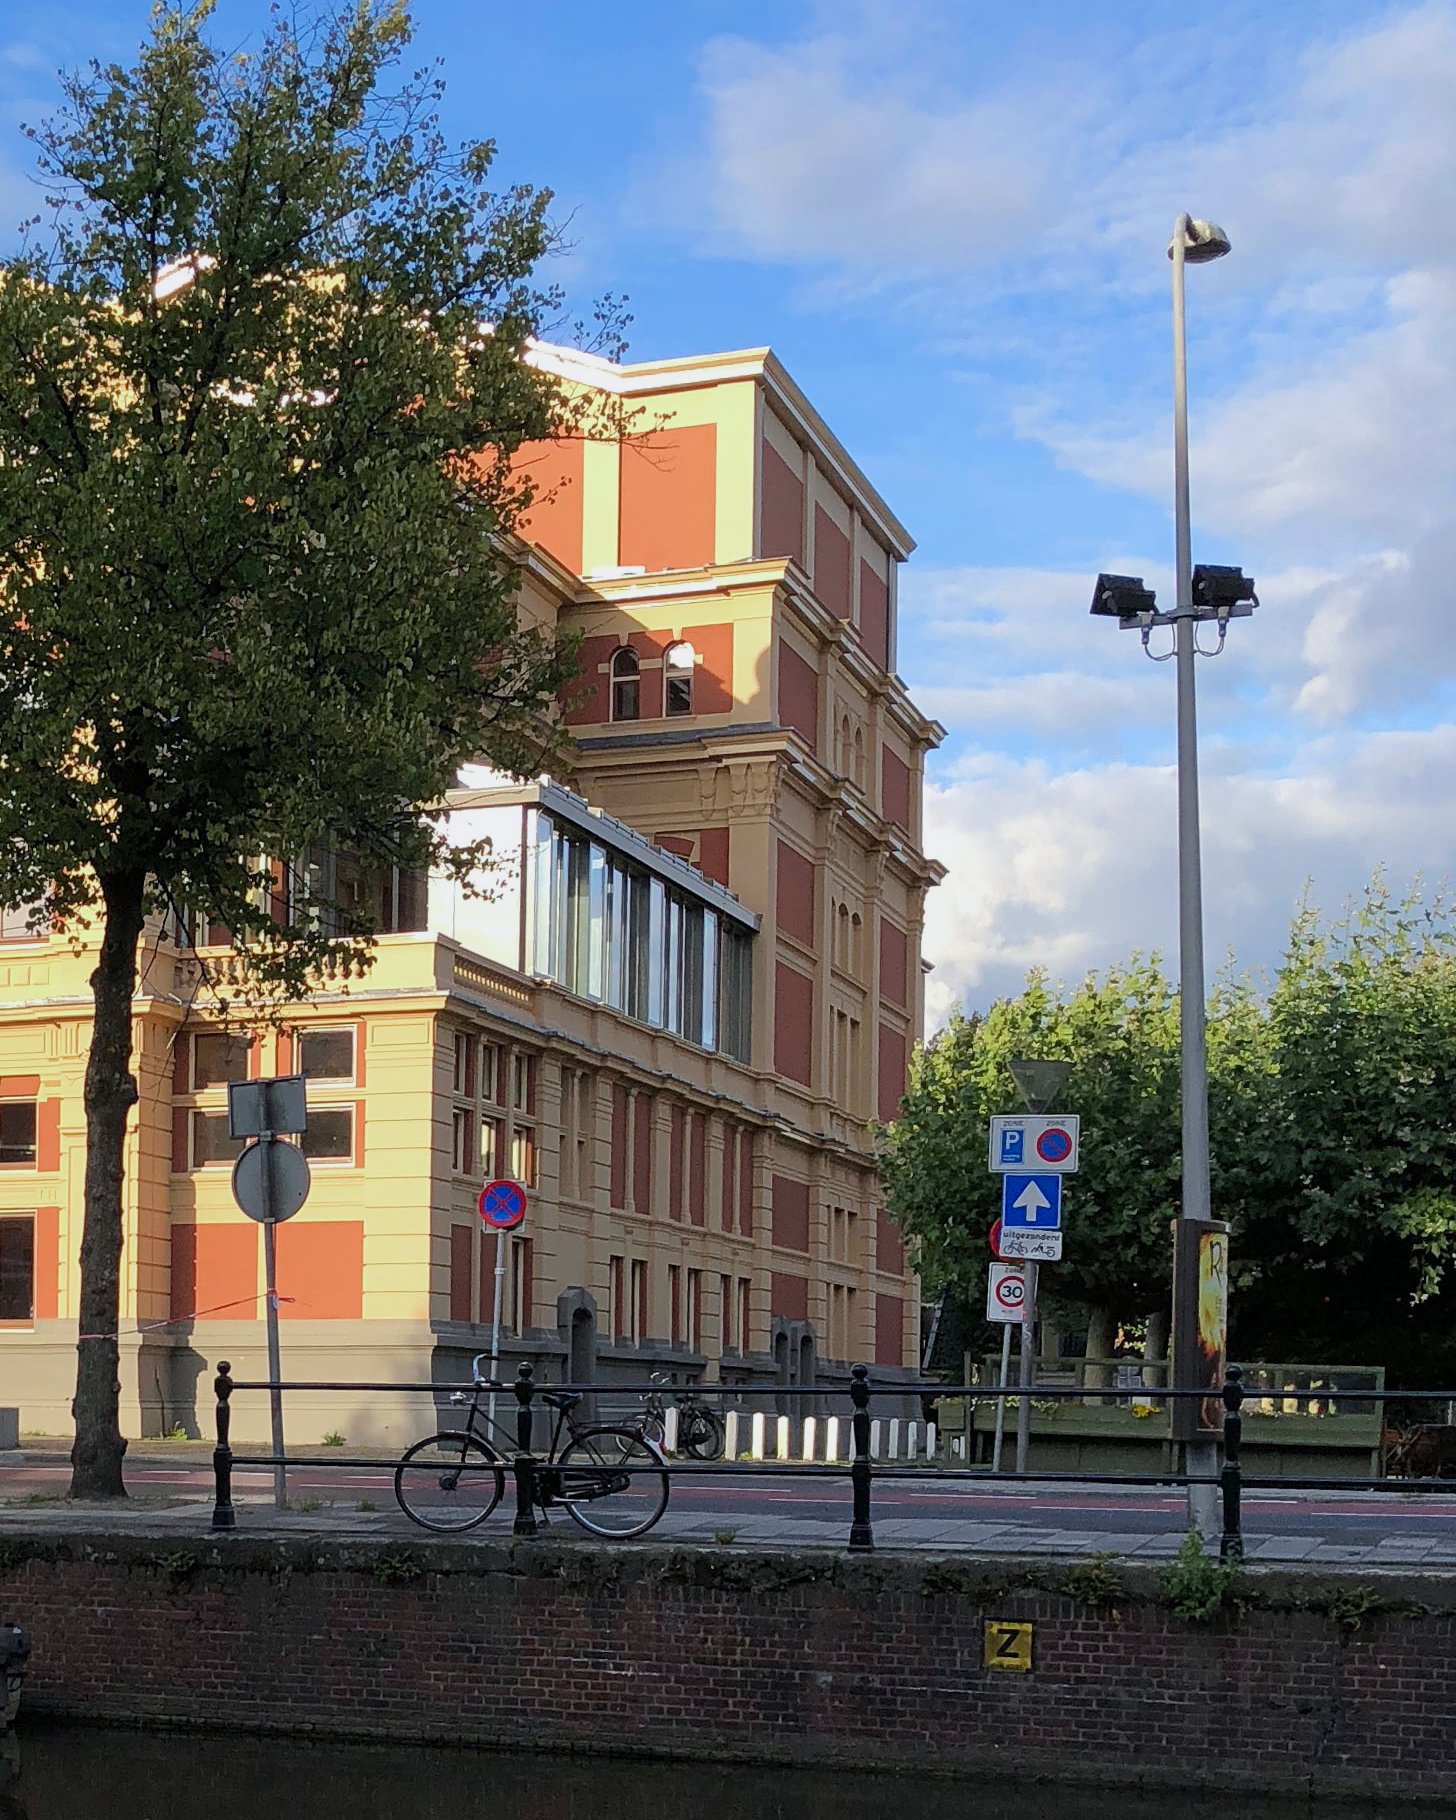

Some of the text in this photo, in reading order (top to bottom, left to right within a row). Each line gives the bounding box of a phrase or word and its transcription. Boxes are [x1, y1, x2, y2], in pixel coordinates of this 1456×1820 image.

[1005, 1131, 1020, 1150] P
[1003, 1230, 1061, 1242] uitgezonderd
[1002, 1285, 1023, 1299] 30
[997, 1628, 1020, 1658] Z
